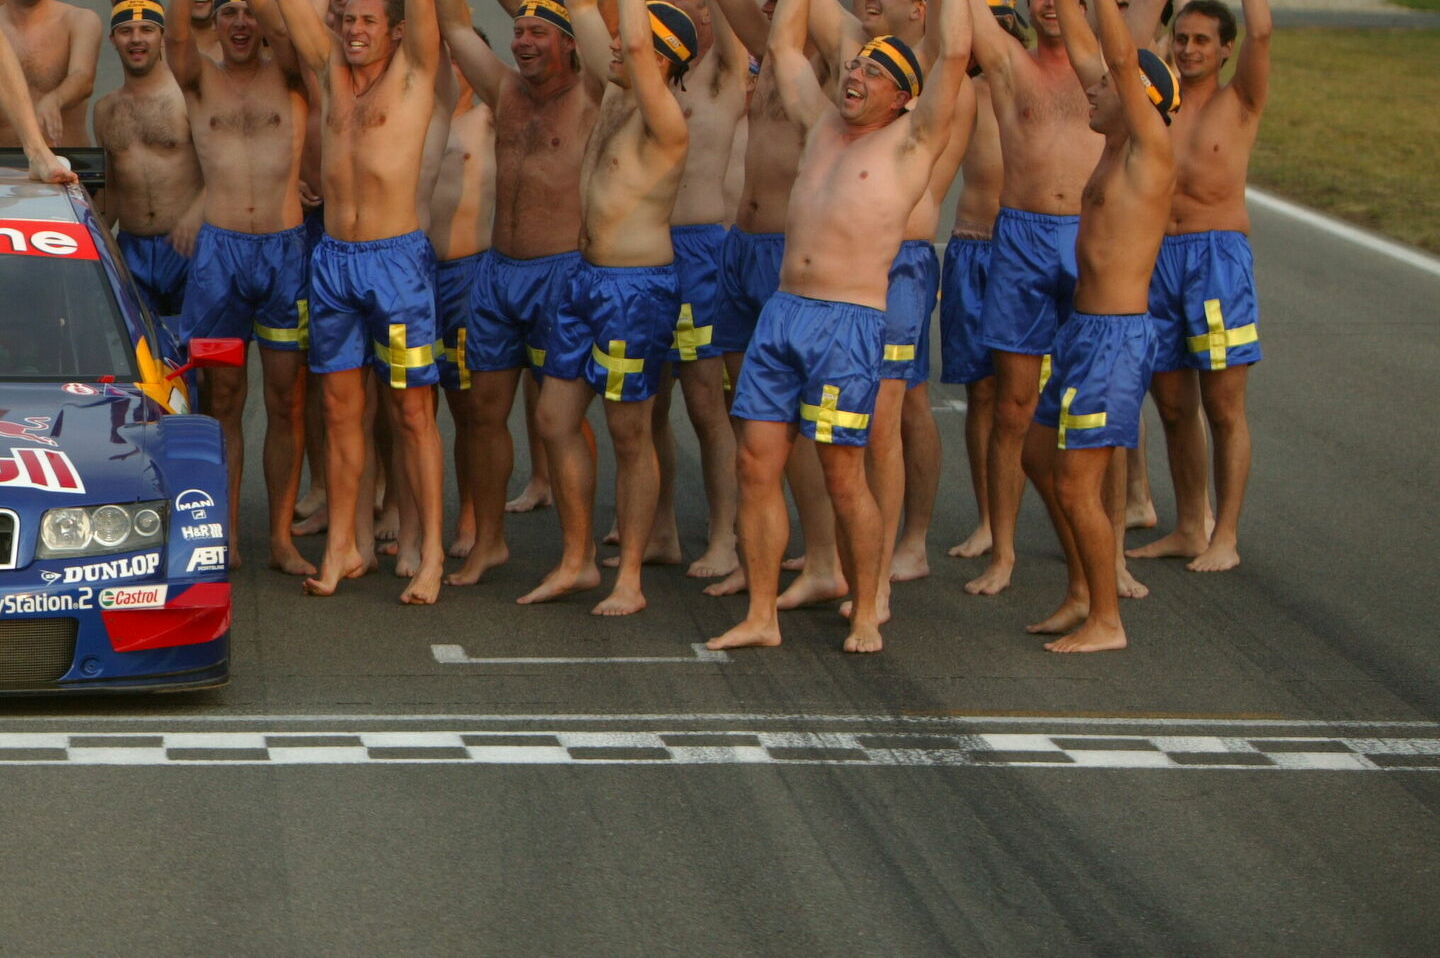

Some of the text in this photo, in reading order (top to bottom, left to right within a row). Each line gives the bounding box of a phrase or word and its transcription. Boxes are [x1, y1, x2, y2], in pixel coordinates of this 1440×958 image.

[179, 499, 212, 511] MAN
[63, 552, 160, 583] DUNLOP
[186, 546, 225, 572] ABT
[115, 588, 159, 605] Castrol
